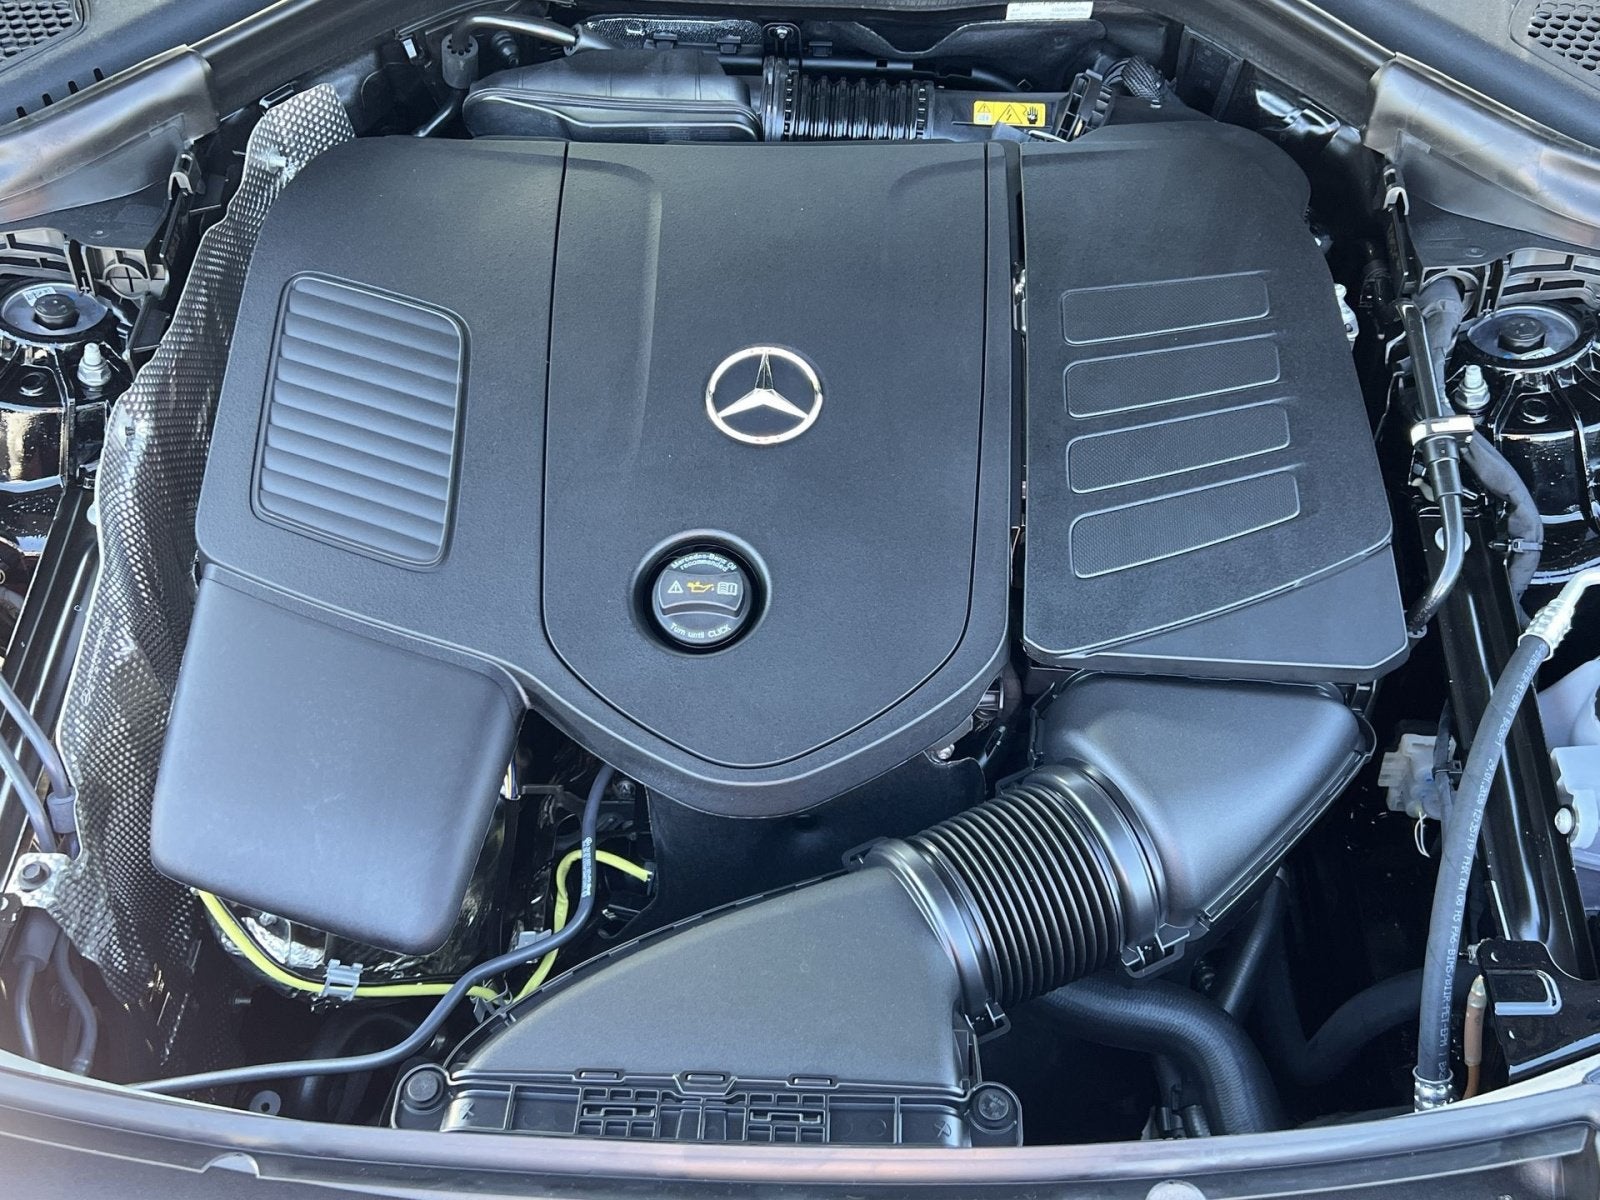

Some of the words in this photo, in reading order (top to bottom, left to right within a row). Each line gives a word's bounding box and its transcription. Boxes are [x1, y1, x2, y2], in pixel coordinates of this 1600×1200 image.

[671, 551, 727, 568] Mercedes-Benz
[680, 559, 728, 572] recommended
[670, 622, 686, 636] Turn
[687, 630, 705, 639] until
[707, 624, 731, 638] CLICK
